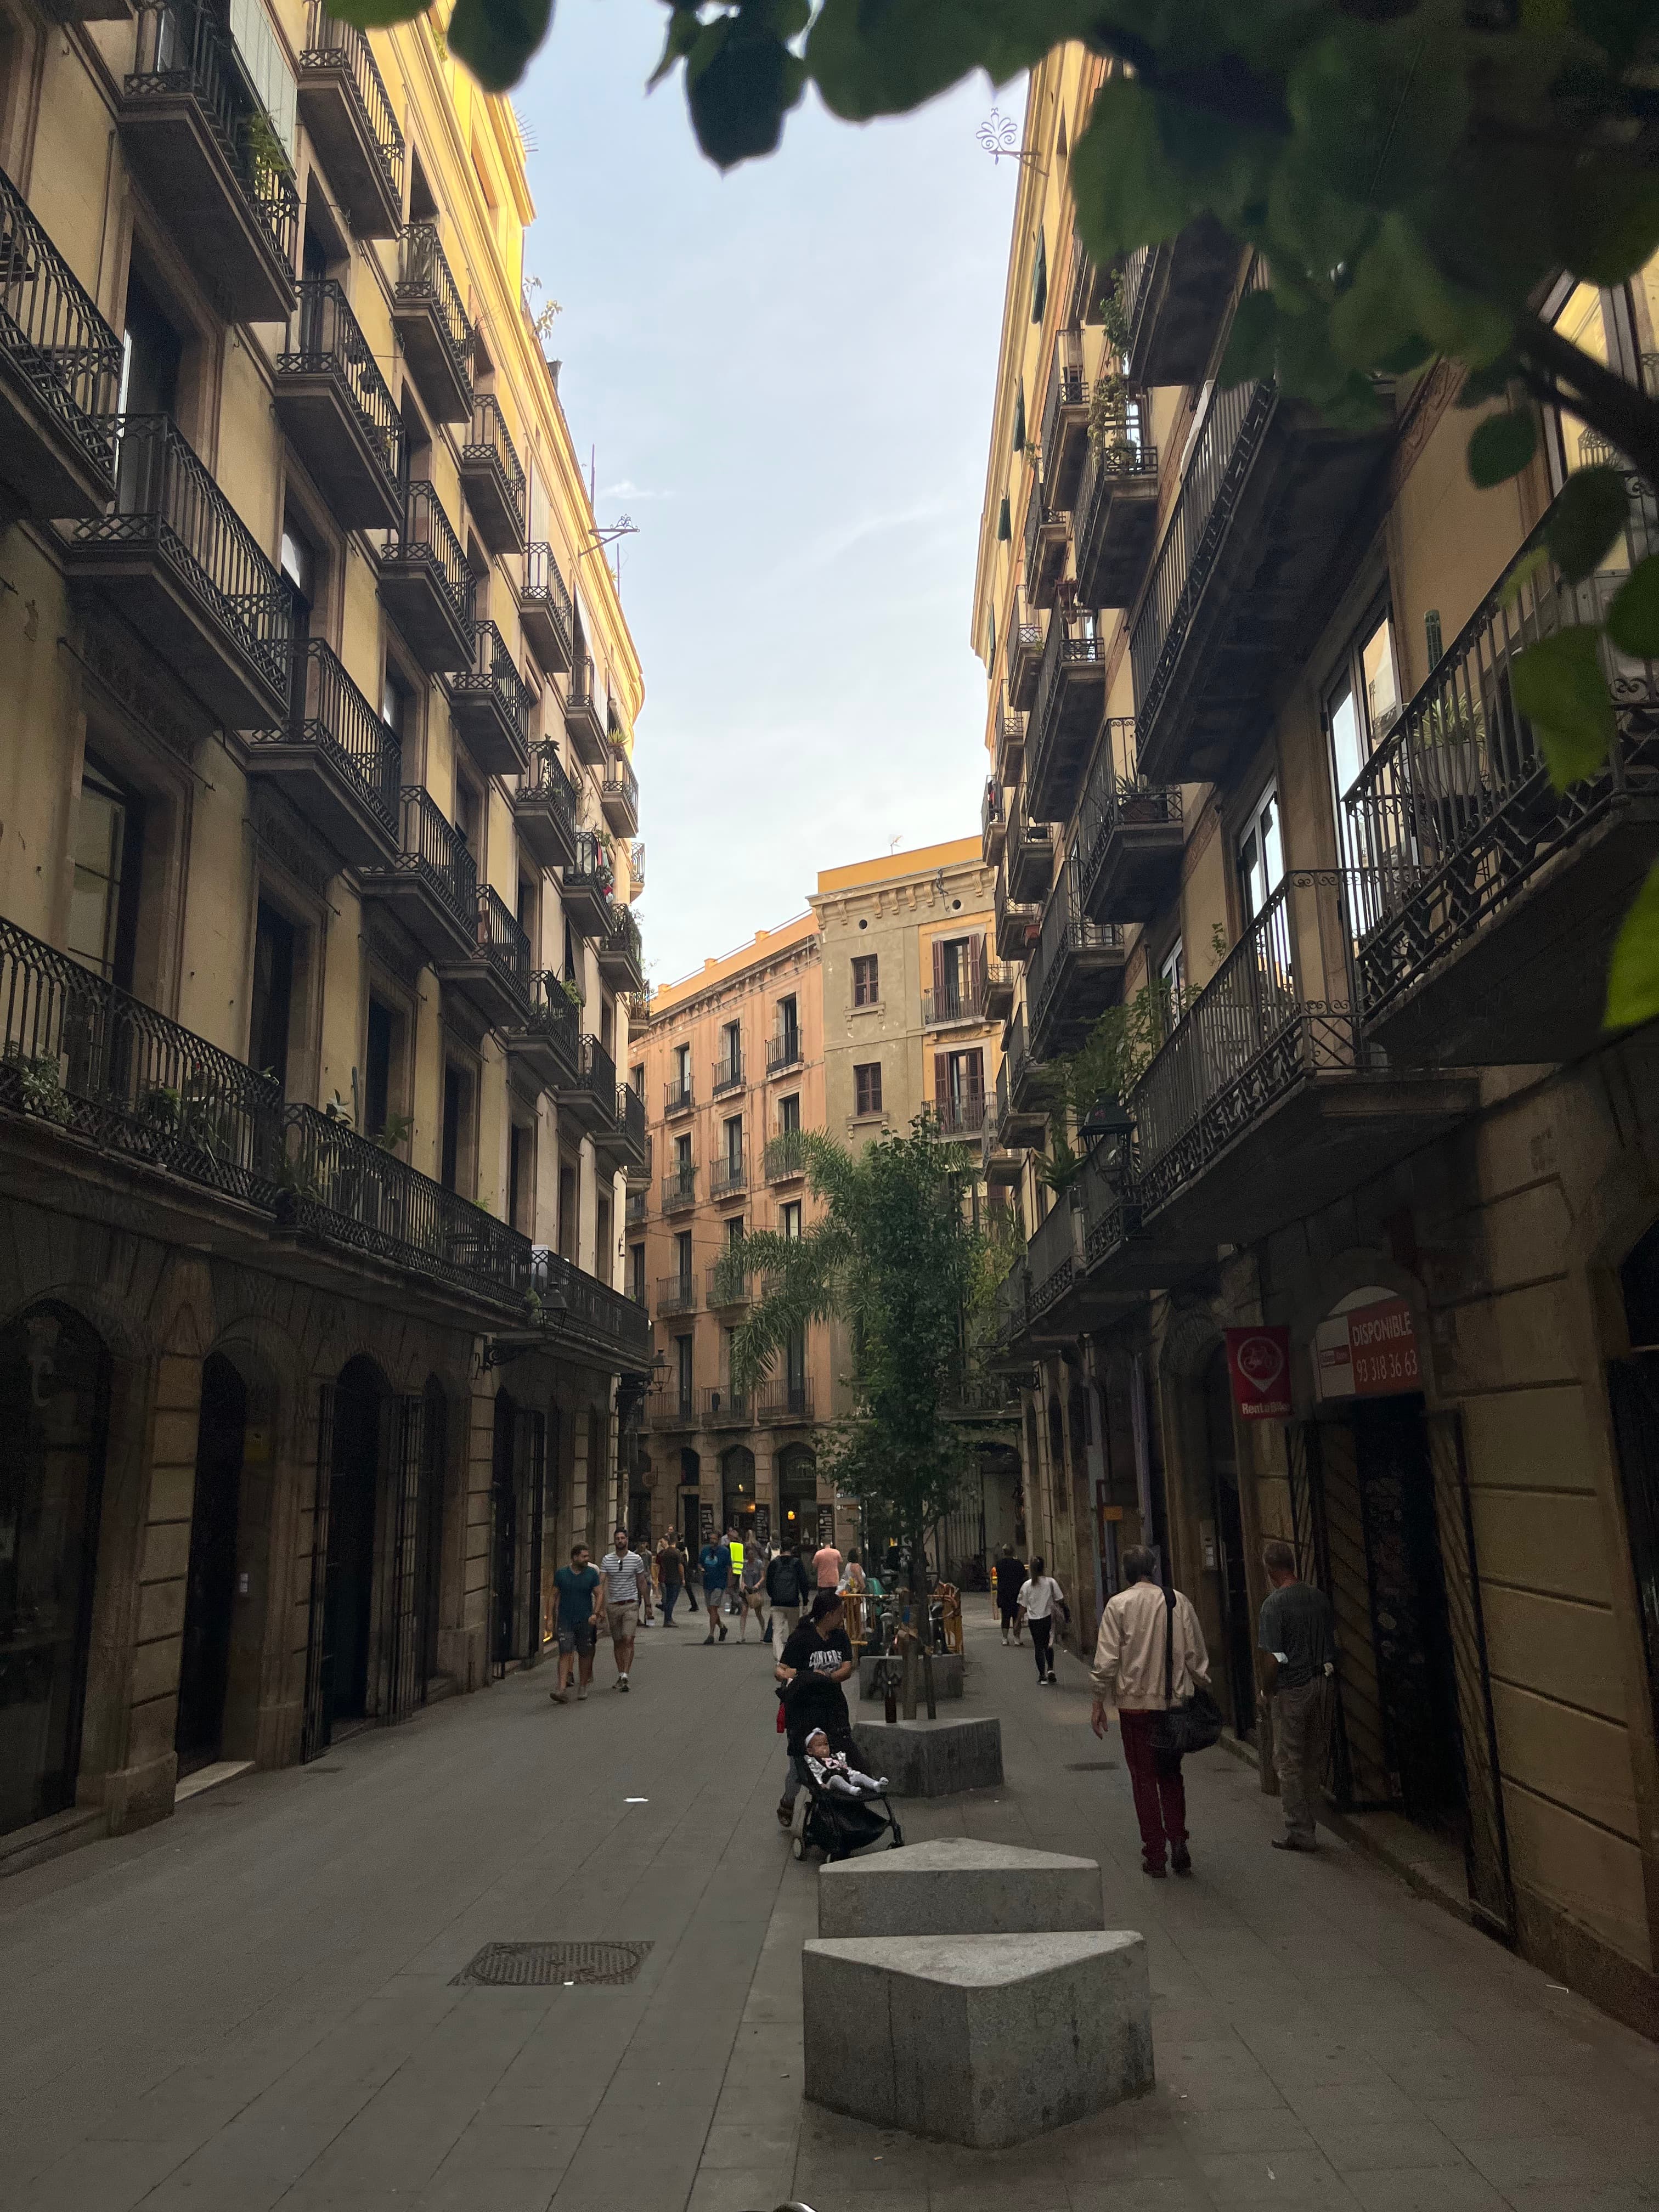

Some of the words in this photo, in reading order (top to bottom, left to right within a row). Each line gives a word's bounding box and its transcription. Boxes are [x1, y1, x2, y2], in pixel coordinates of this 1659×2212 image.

[1352, 1312, 1413, 1346] DISPONIBLE
[1357, 1358, 1368, 1382] 93
[1370, 1355, 1387, 1381] 318
[1389, 1352, 1402, 1378] 36
[1404, 1349, 1418, 1376] 63
